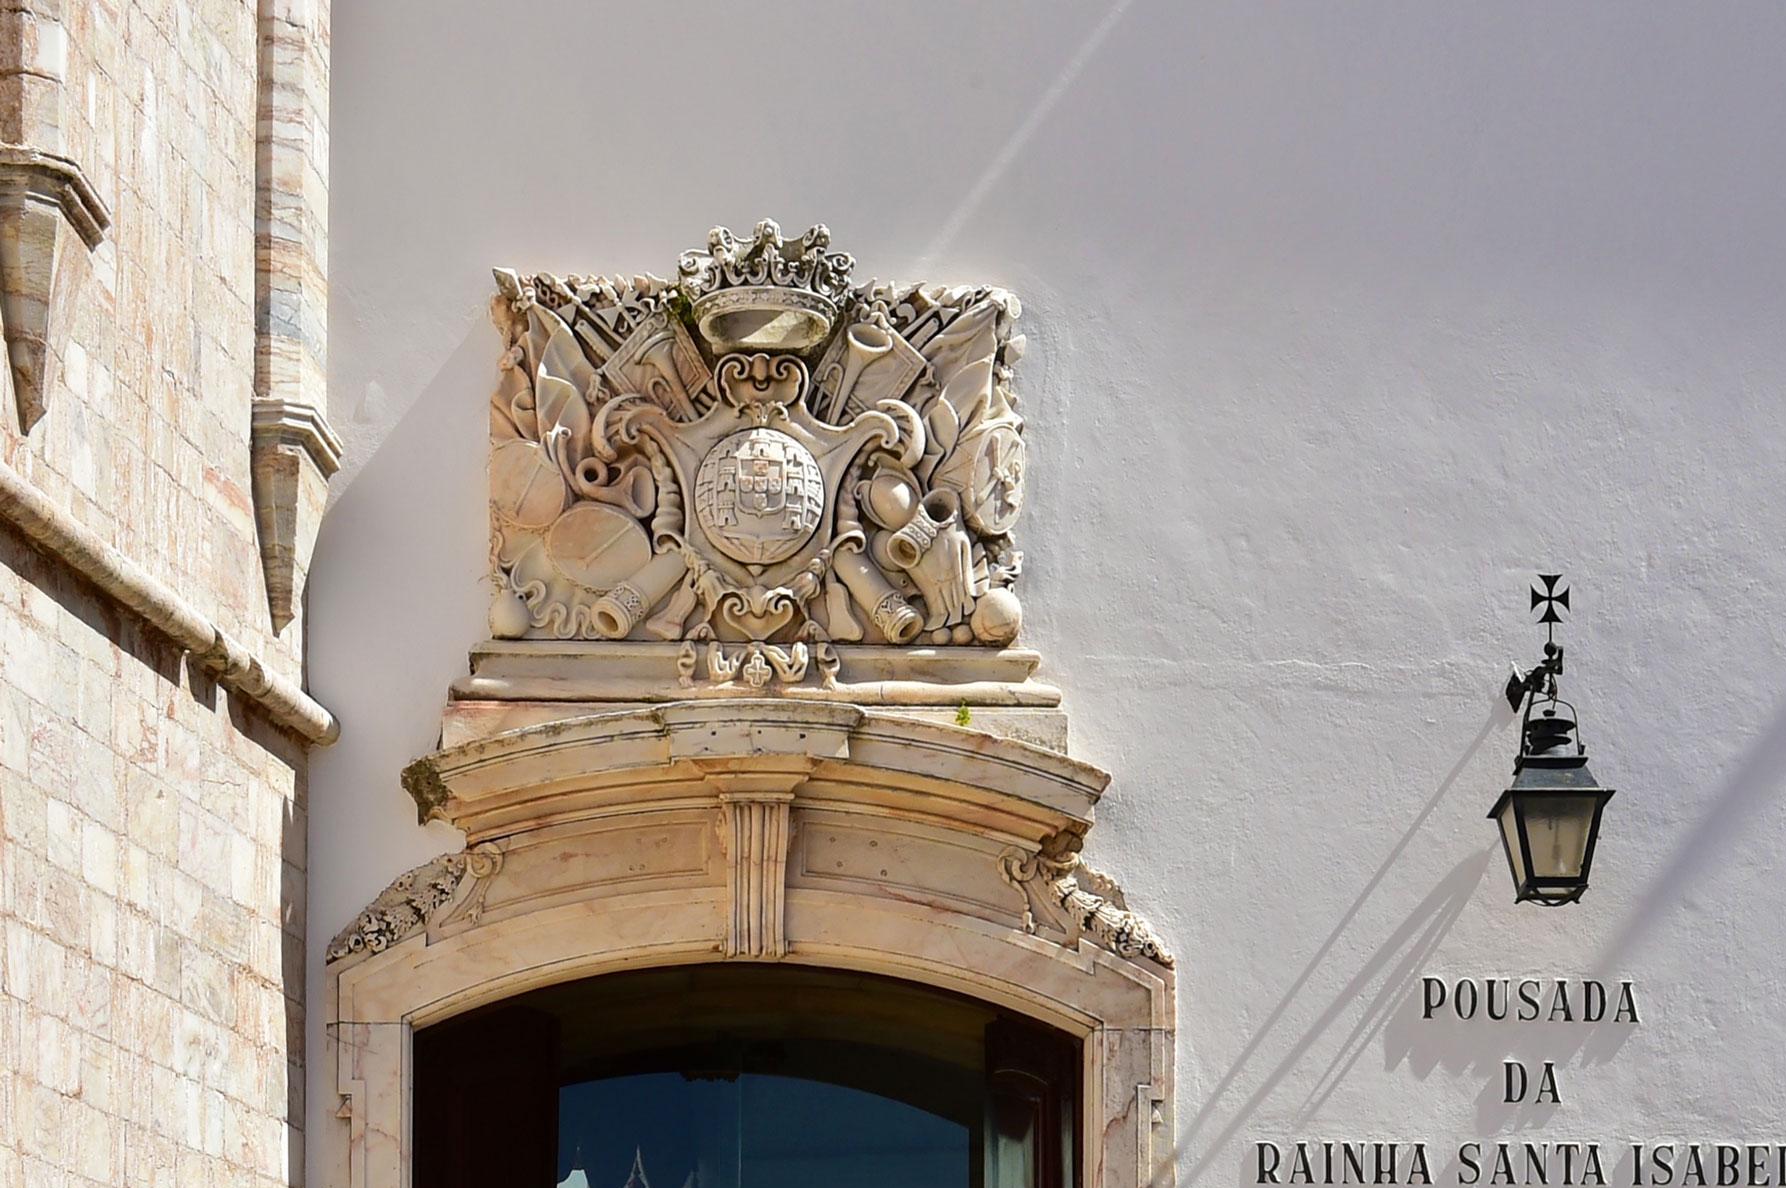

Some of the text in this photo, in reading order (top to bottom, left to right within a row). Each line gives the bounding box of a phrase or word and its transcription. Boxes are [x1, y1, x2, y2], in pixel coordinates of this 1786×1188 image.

[1422, 978, 1639, 1023] POUSADA
[1503, 1062, 1562, 1104] DA
[1256, 1142, 1432, 1185] RAINHA
[1458, 1143, 1606, 1186] SANTA
